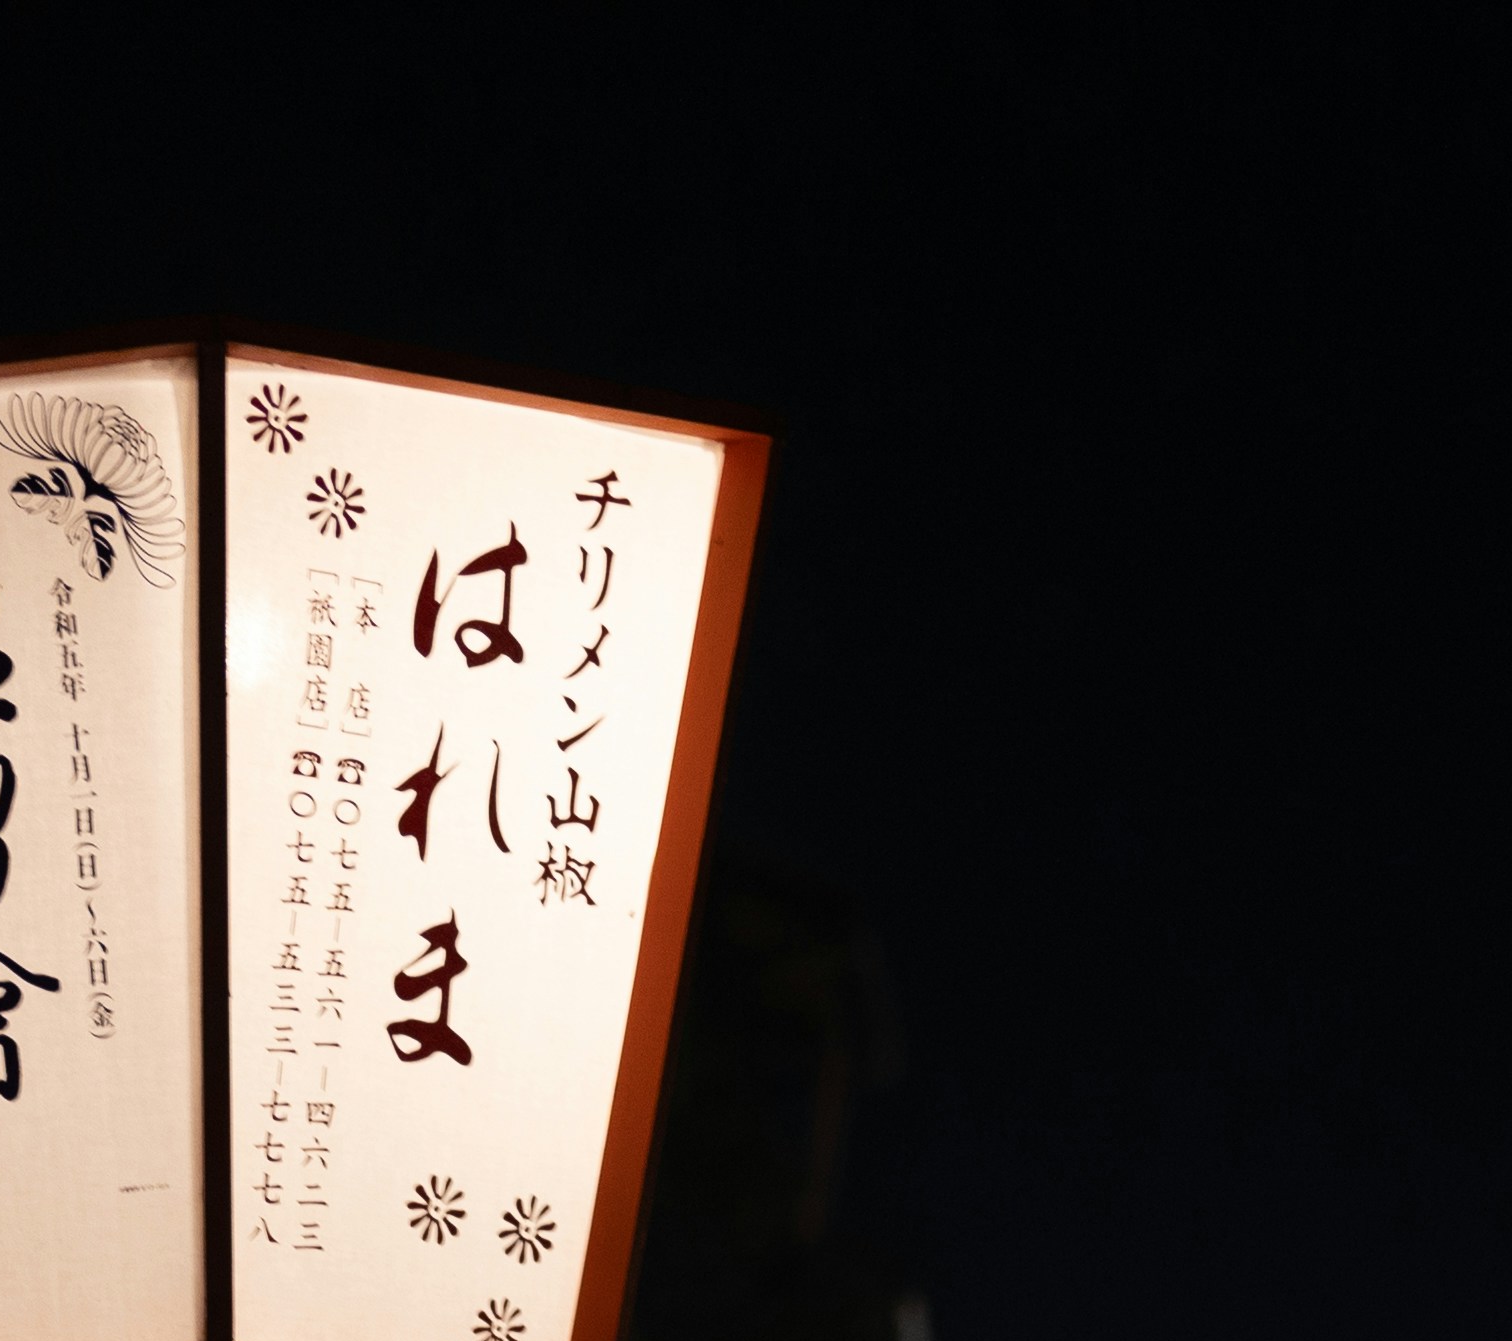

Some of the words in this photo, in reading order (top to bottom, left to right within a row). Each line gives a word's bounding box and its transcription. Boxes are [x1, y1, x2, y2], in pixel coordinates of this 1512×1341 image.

[48, 576, 88, 703] 令和五年
[386, 519, 529, 1069] はれま
[532, 468, 634, 908] チリメン山椒
